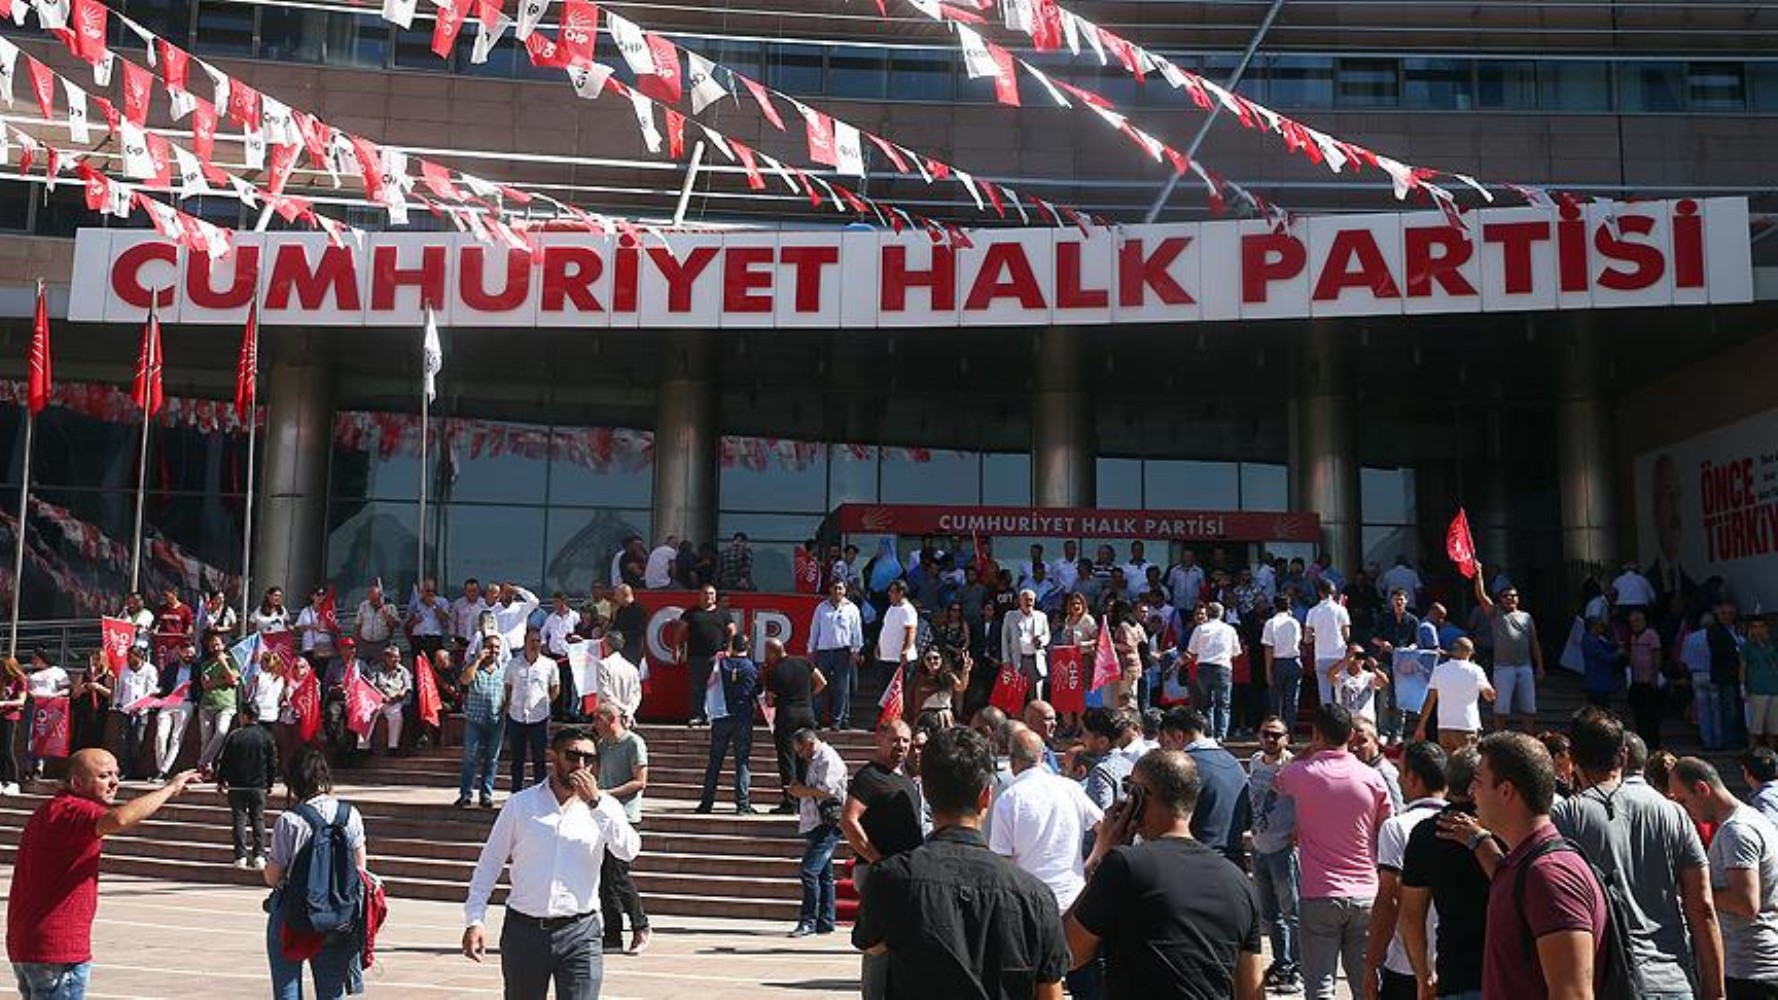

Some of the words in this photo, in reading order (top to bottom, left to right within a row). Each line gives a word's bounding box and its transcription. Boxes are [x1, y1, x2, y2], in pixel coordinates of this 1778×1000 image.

[111, 233, 838, 312] CUMHURİYET
[881, 236, 1197, 311] HALK
[1241, 198, 1705, 303] PARTİSİ
[1701, 458, 1755, 515] ÖNCE
[938, 512, 1074, 532] CUMHURİYET
[1082, 518, 1136, 534] HALK
[1145, 516, 1225, 536] PARTİSİ
[1069, 660, 1079, 690] CHP
